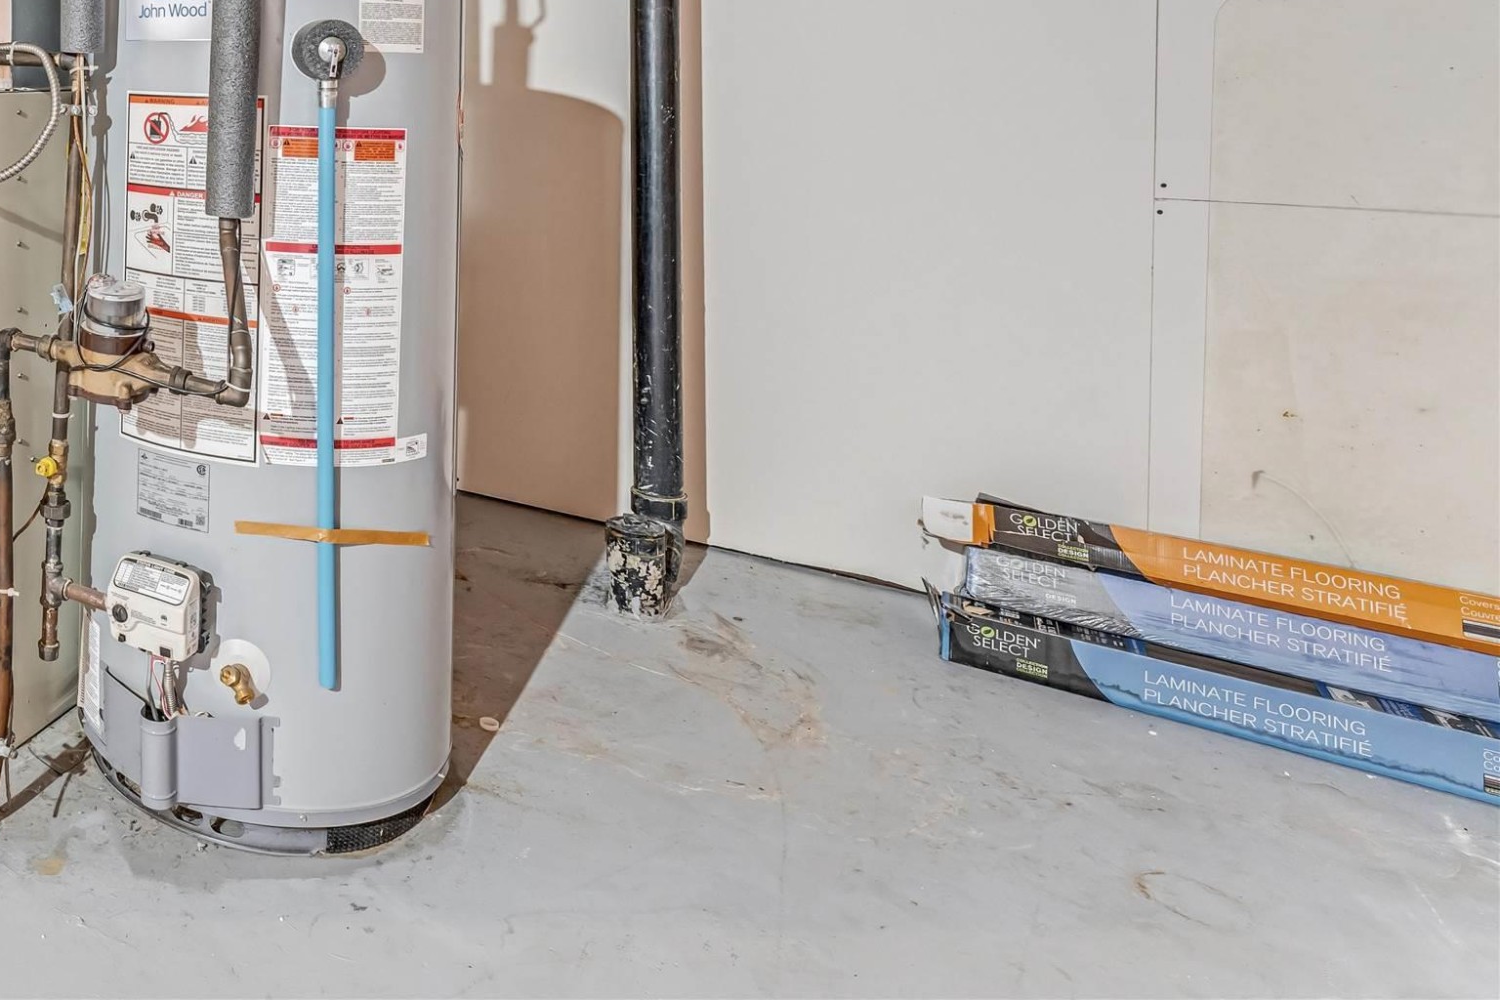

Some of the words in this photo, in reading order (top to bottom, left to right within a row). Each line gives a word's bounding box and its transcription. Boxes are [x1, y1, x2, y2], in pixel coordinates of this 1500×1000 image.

[138, 3, 165, 18] John
[176, 191, 204, 199] DANGER
[1010, 513, 1078, 534] GOLDEN
[1017, 525, 1072, 542] SELECT
[1058, 548, 1089, 559] DESIGN
[996, 556, 1066, 578] GOLDEN
[1183, 547, 1284, 578] LAMINATE
[1290, 566, 1401, 600] FLOORING
[1002, 568, 1058, 589] SELECT
[1045, 593, 1077, 605] DESIGN
[1184, 564, 1295, 598] PLANCHER
[1301, 587, 1408, 619] STRATIFIÉ
[1170, 595, 1269, 627] LAMINATE
[1276, 616, 1385, 652] FLOORING
[966, 623, 1038, 649] GOLDEN
[972, 635, 1030, 658] SELECT
[1171, 612, 1280, 649] PLANCHER
[1287, 638, 1393, 673] STRATIFIÉ
[1016, 662, 1049, 675] DESIGN
[1144, 670, 1247, 708] LAMINATE
[1253, 696, 1366, 736] FLOORING
[1144, 688, 1257, 728] PLANCHER
[1263, 718, 1373, 758] STRATIFIÉ
